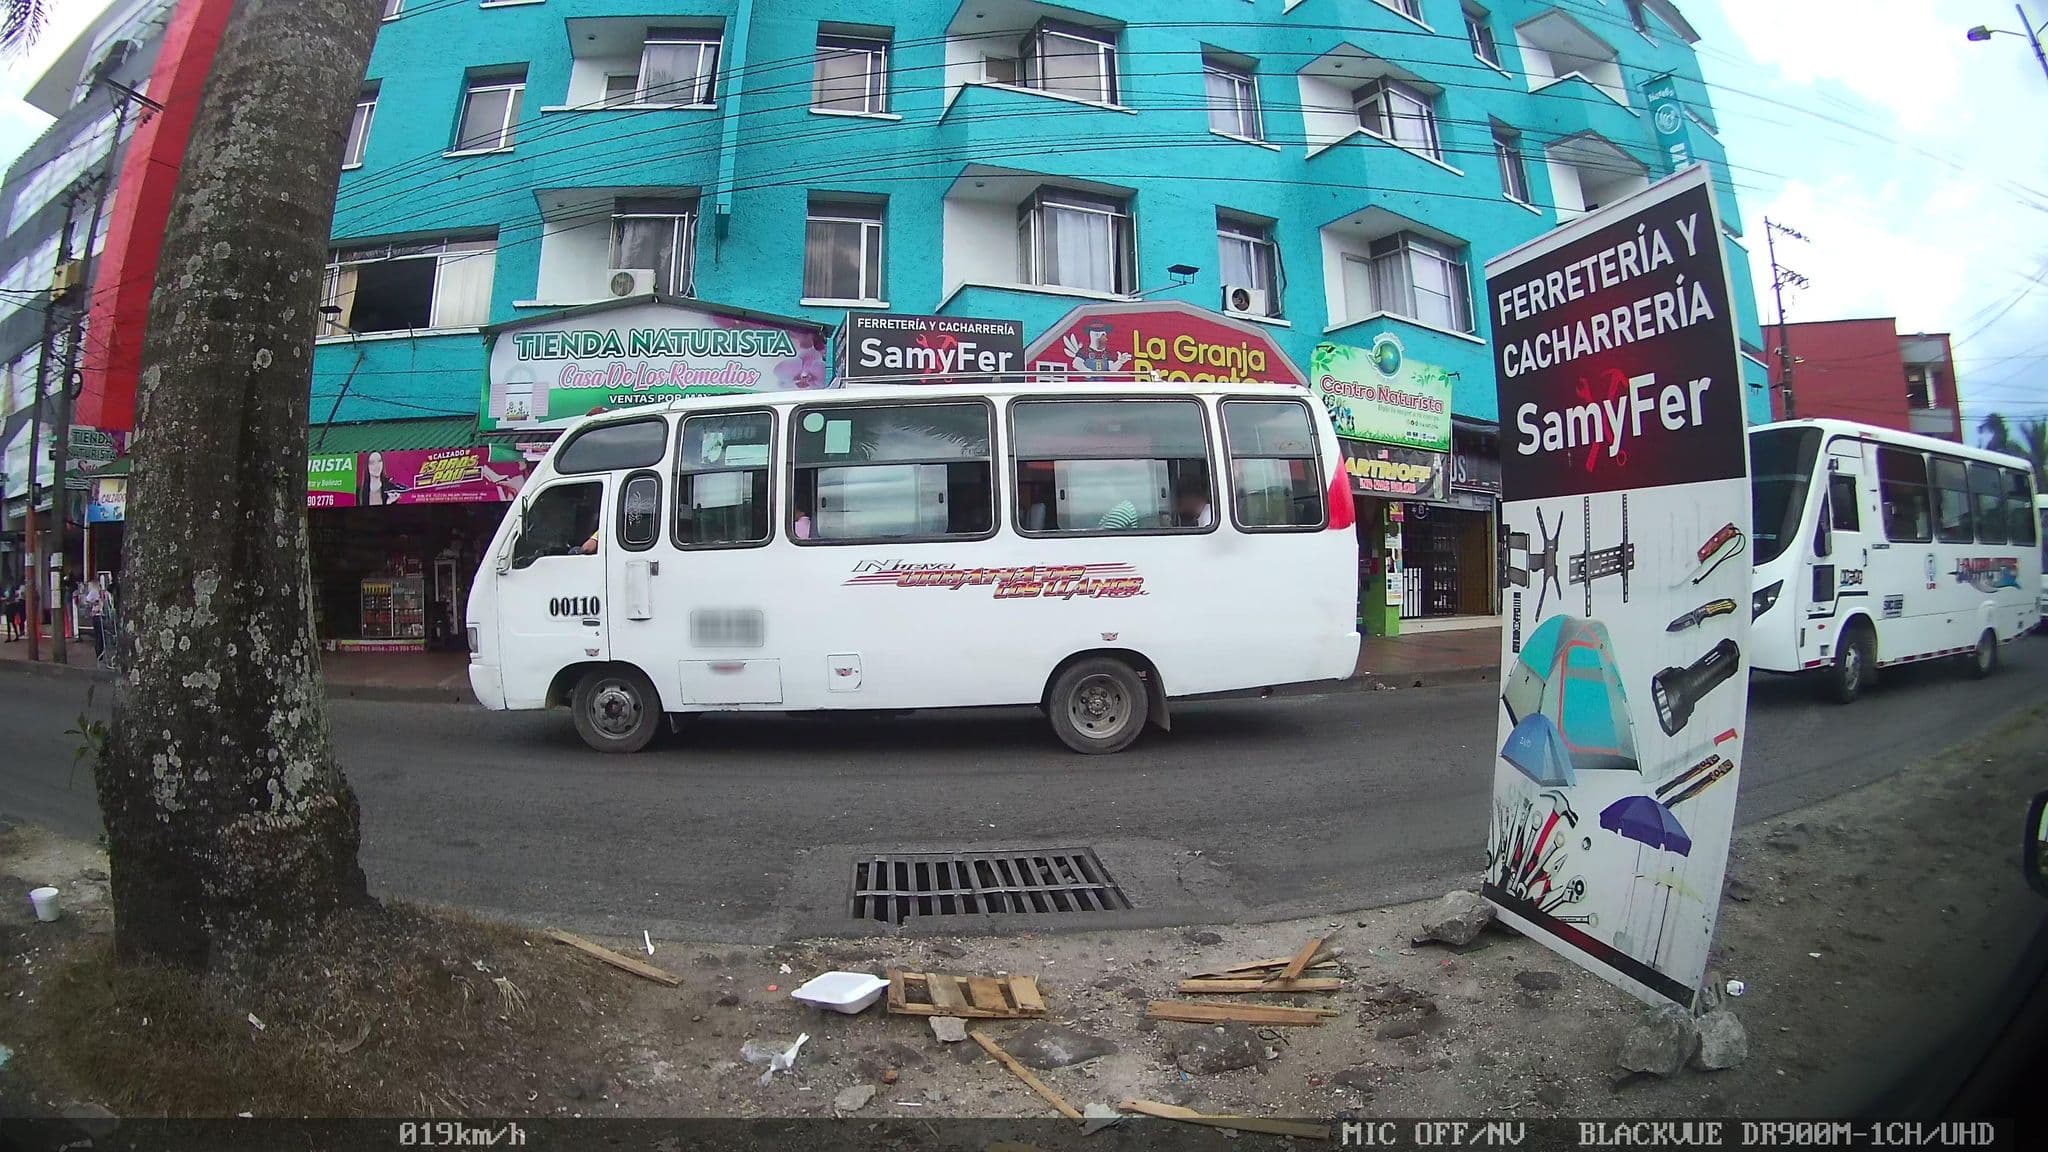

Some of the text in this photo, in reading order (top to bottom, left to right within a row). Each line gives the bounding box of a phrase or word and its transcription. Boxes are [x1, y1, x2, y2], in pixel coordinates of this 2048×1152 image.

[1498, 213, 1698, 327] FERRETERÍA Y
[858, 317, 1016, 336] FERRETERÍA Y CACHARRERÍA
[1503, 273, 1715, 379] CACHARRERÍA
[514, 328, 797, 360] TIENDA NATURISTA
[860, 336, 1014, 375] SamyFer
[1133, 329, 1266, 378] La Granja
[560, 360, 761, 391] Casa De Los Remedios
[609, 394, 654, 404] VENTAS
[657, 394, 681, 403] POR
[1320, 375, 1376, 401] Centro
[1377, 384, 1444, 414] Naturista
[1516, 372, 1712, 458] SamyFer
[72, 430, 113, 447] TIENDA
[433, 450, 464, 460] CALZADO
[316, 494, 334, 506] 2776
[550, 595, 601, 617] 00110
